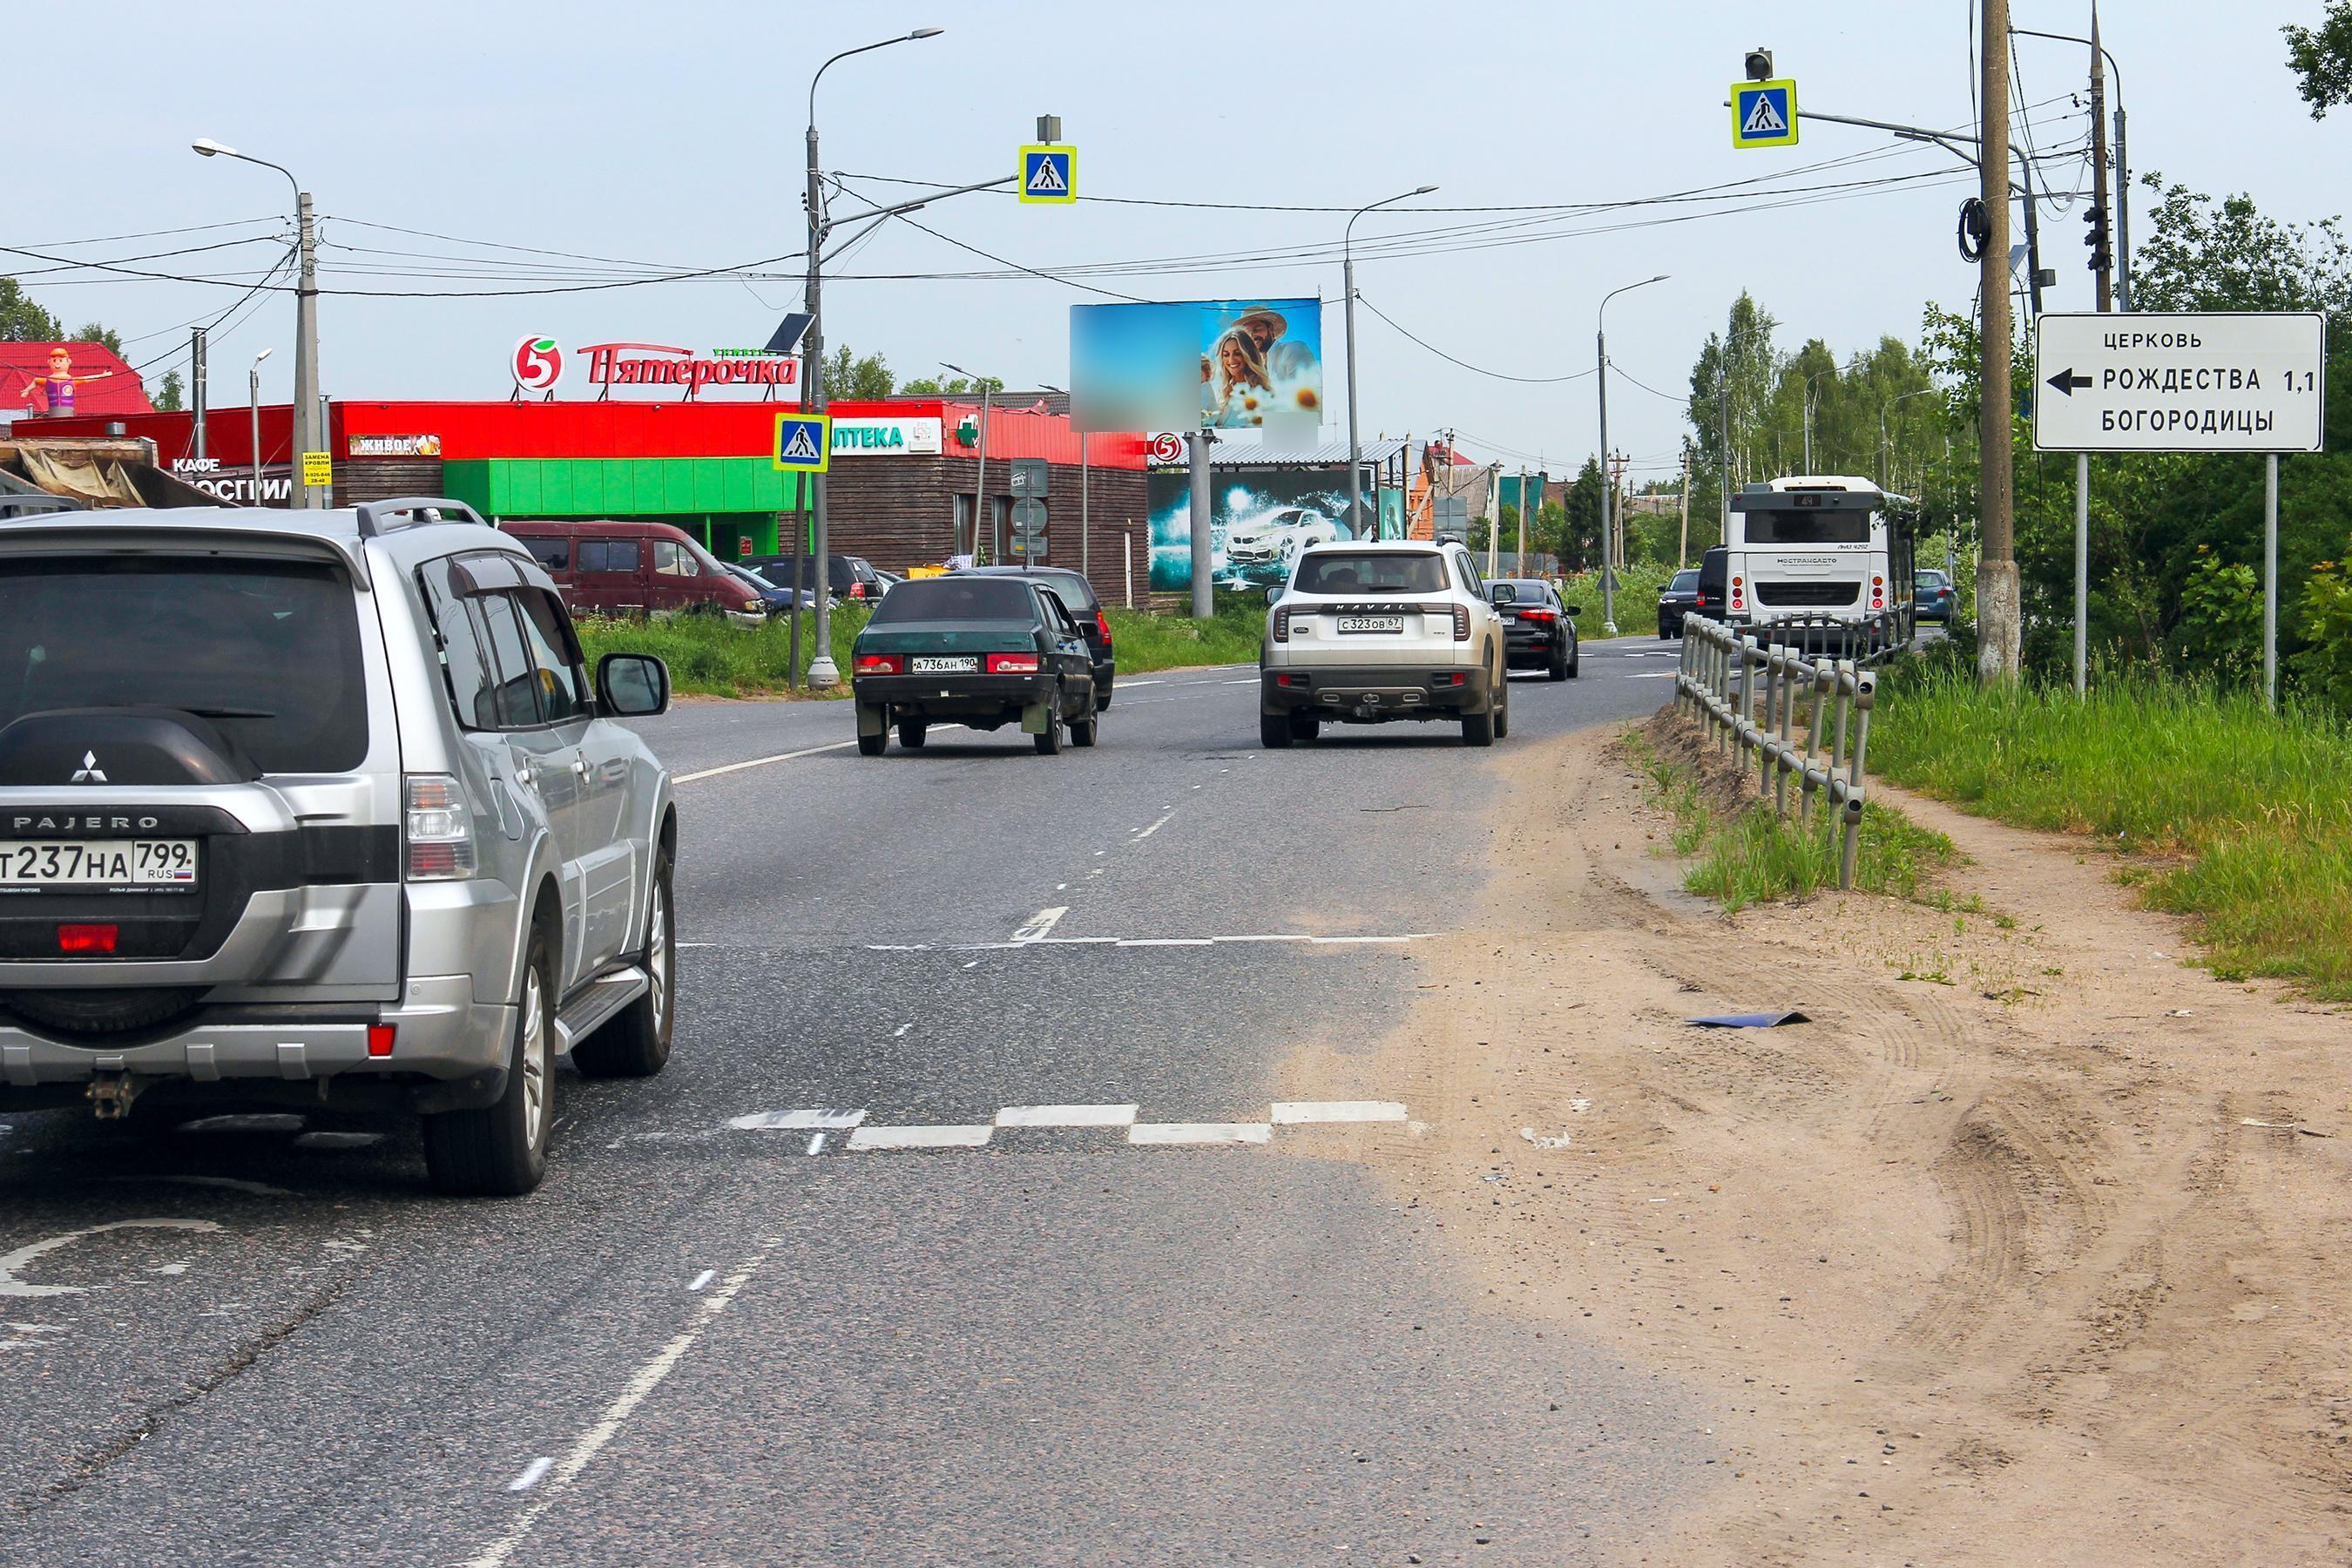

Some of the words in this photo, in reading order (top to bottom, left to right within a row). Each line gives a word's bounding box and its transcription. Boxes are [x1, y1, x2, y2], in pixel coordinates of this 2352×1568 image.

[2104, 333, 2202, 350] ЦЕРКОВЬ
[2103, 368, 2261, 394] РОЖДЕСТВА
[2283, 370, 2315, 394] 1,1
[2101, 409, 2274, 436] БОГОРОДИЦЫ
[360, 438, 412, 451] ЖИВОЕ
[831, 427, 903, 447] ПТЕКА
[173, 458, 220, 472] КАФЕ
[13, 816, 159, 829] PAJERO
[136, 842, 188, 869] 799
[147, 869, 173, 879] RUS
